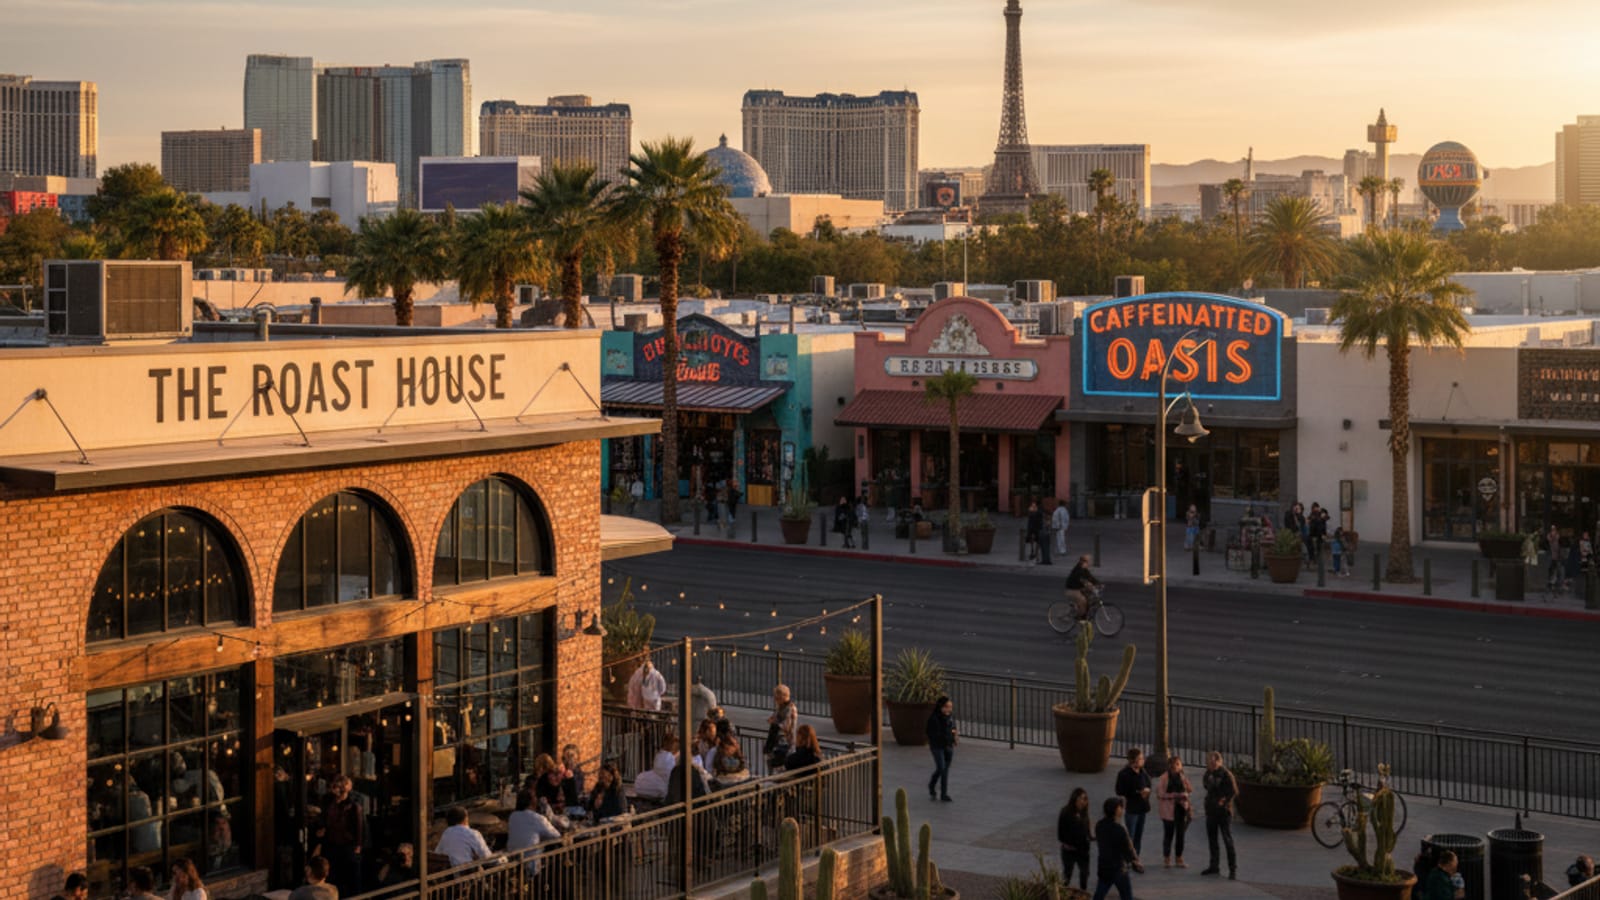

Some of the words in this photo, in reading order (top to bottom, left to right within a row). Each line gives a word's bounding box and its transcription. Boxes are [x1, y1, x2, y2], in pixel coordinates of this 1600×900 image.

[1090, 303, 1272, 336] CAFFEINATTED
[1107, 337, 1252, 384] OASIS
[148, 366, 228, 423] THE
[252, 359, 374, 417] ROAST
[396, 353, 505, 408] HOUSE
